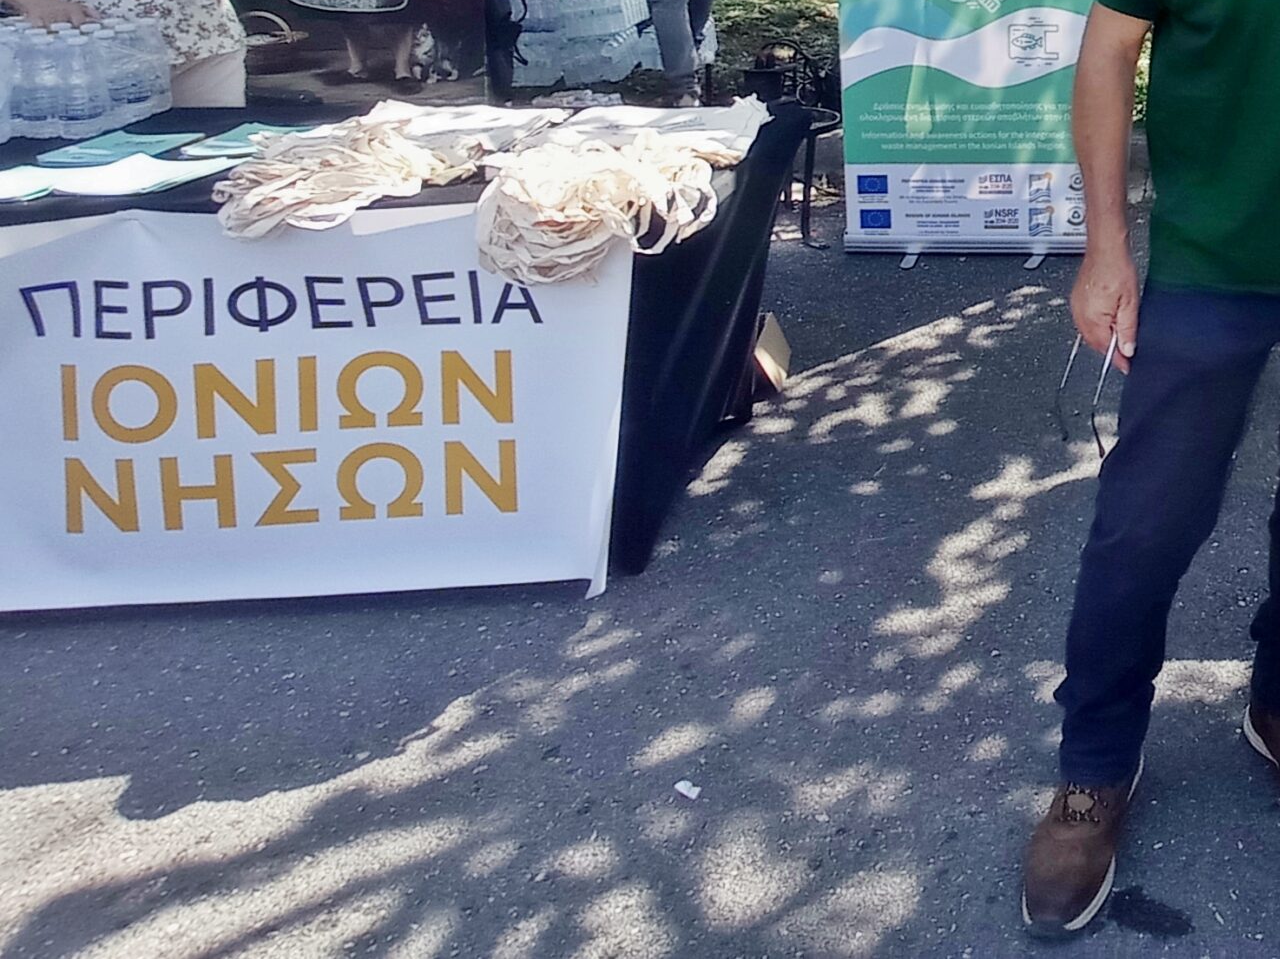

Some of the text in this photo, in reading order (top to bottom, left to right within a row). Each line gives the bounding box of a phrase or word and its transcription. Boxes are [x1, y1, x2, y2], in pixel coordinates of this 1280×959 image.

[995, 208, 1019, 218] NSRF
[20, 270, 543, 340] ΠΕΡΙΦΕΡΕΙΑ
[61, 349, 514, 443] ΙΟΝΙΩΝ
[64, 439, 518, 534] ΝΗΣΩΝ
